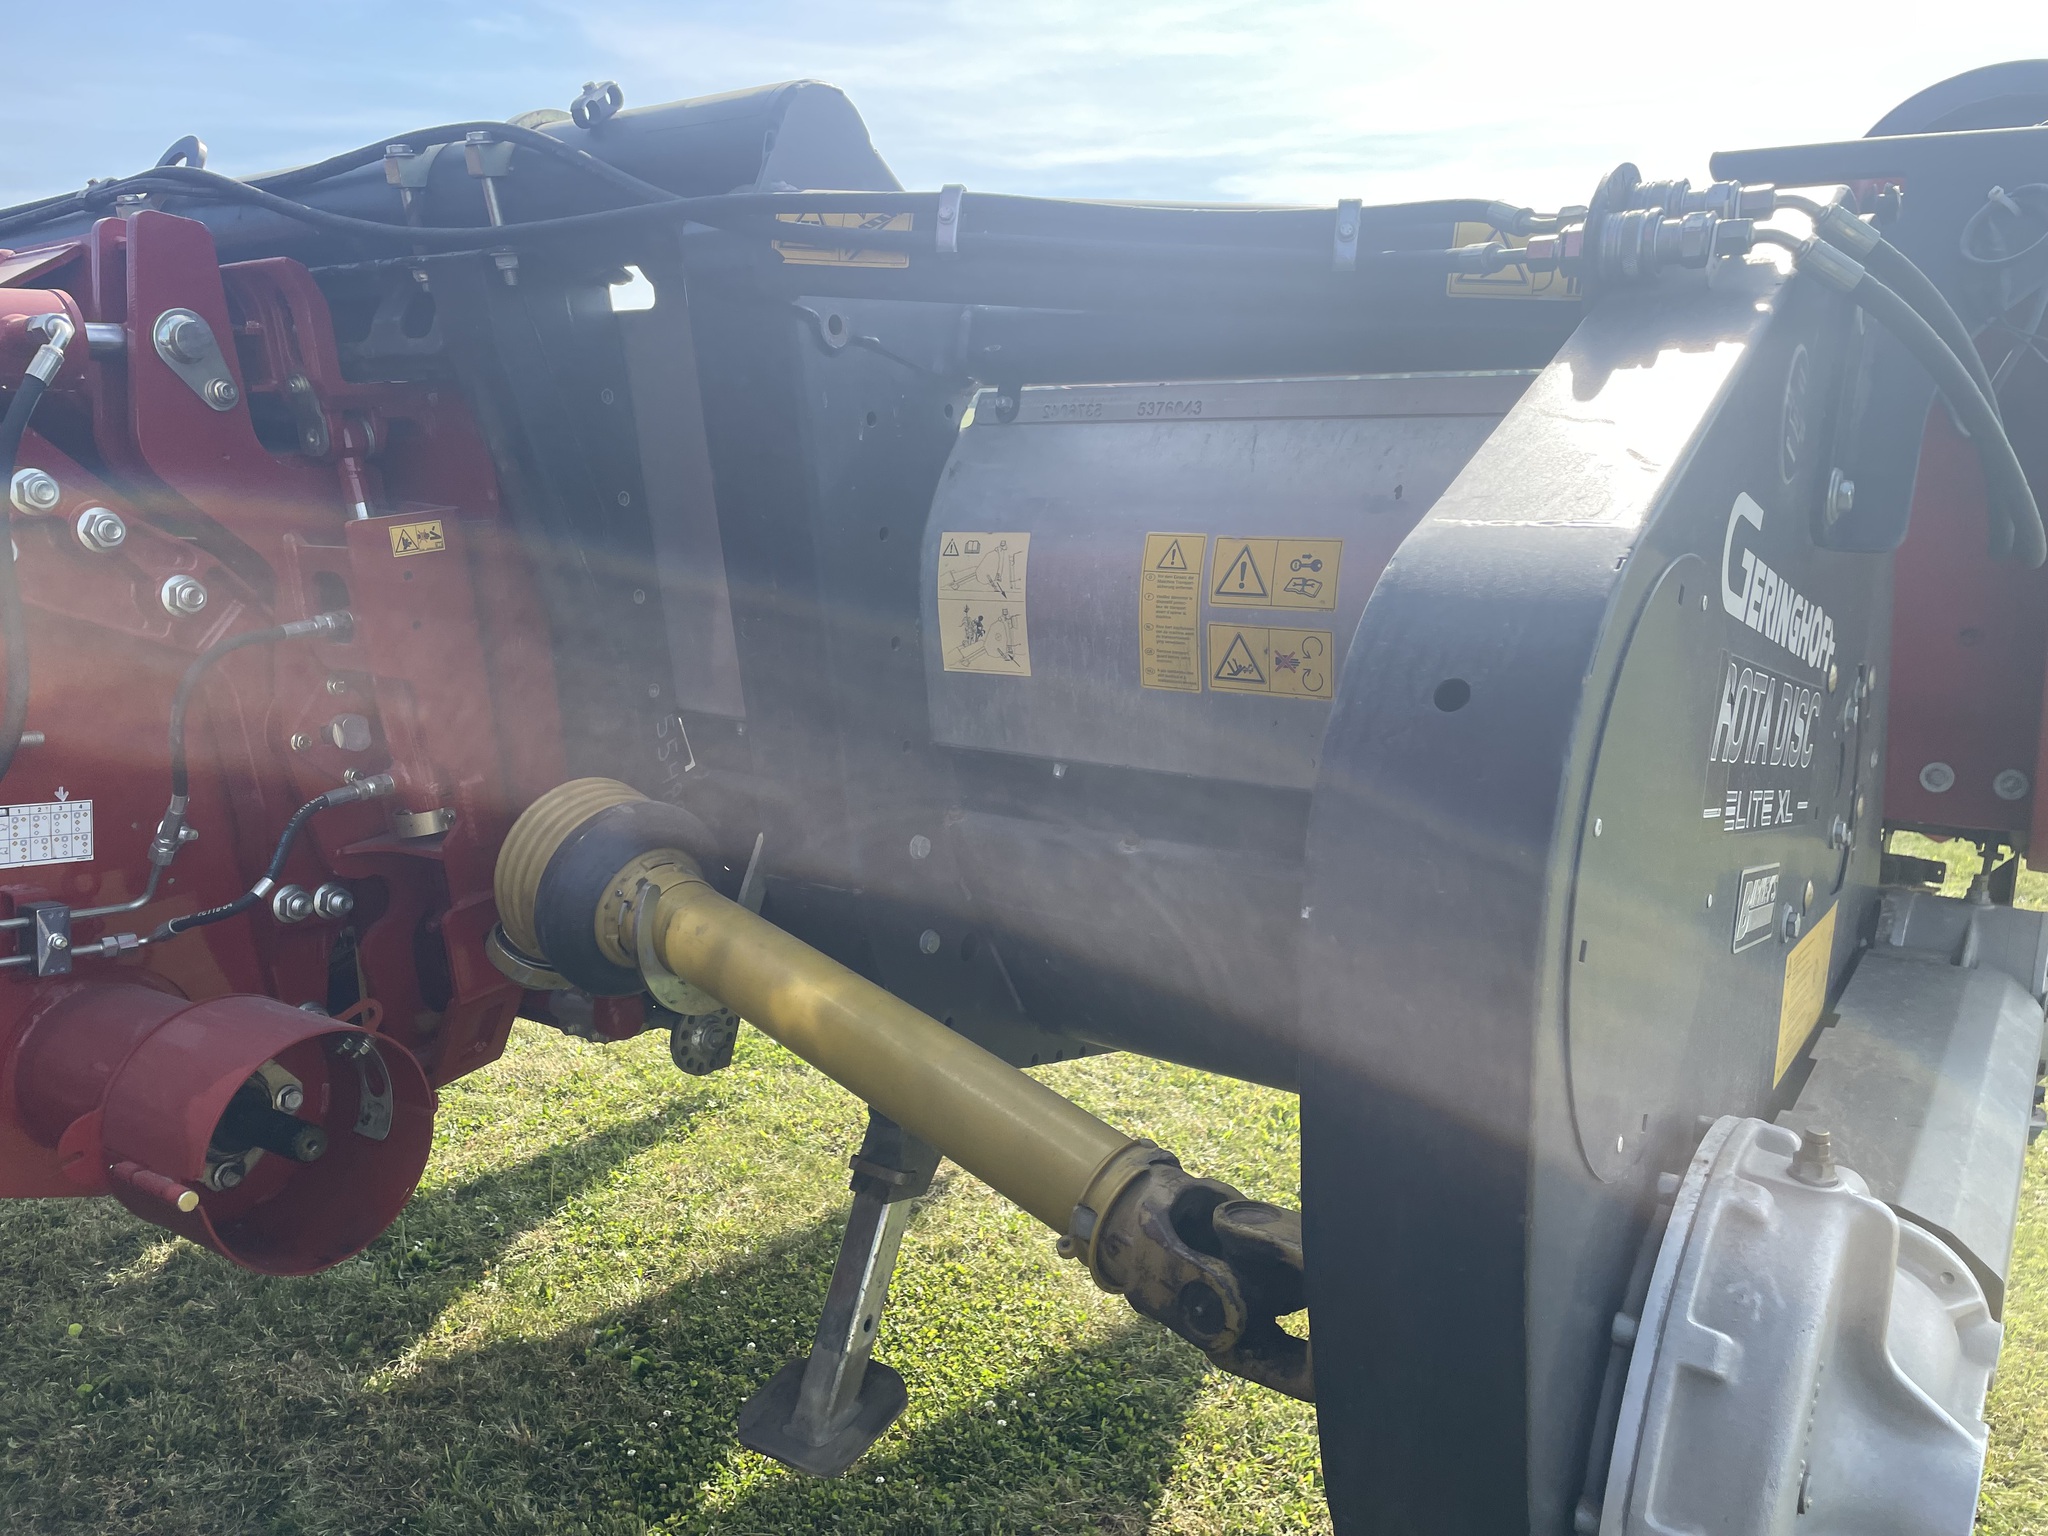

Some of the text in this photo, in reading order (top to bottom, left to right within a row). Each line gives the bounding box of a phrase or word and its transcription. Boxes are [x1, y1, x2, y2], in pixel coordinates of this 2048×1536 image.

[1721, 491, 1836, 673] GERINGHOFF
[1709, 662, 1822, 769] ROTA DISC
[1723, 789, 1794, 832] ELITE XL
